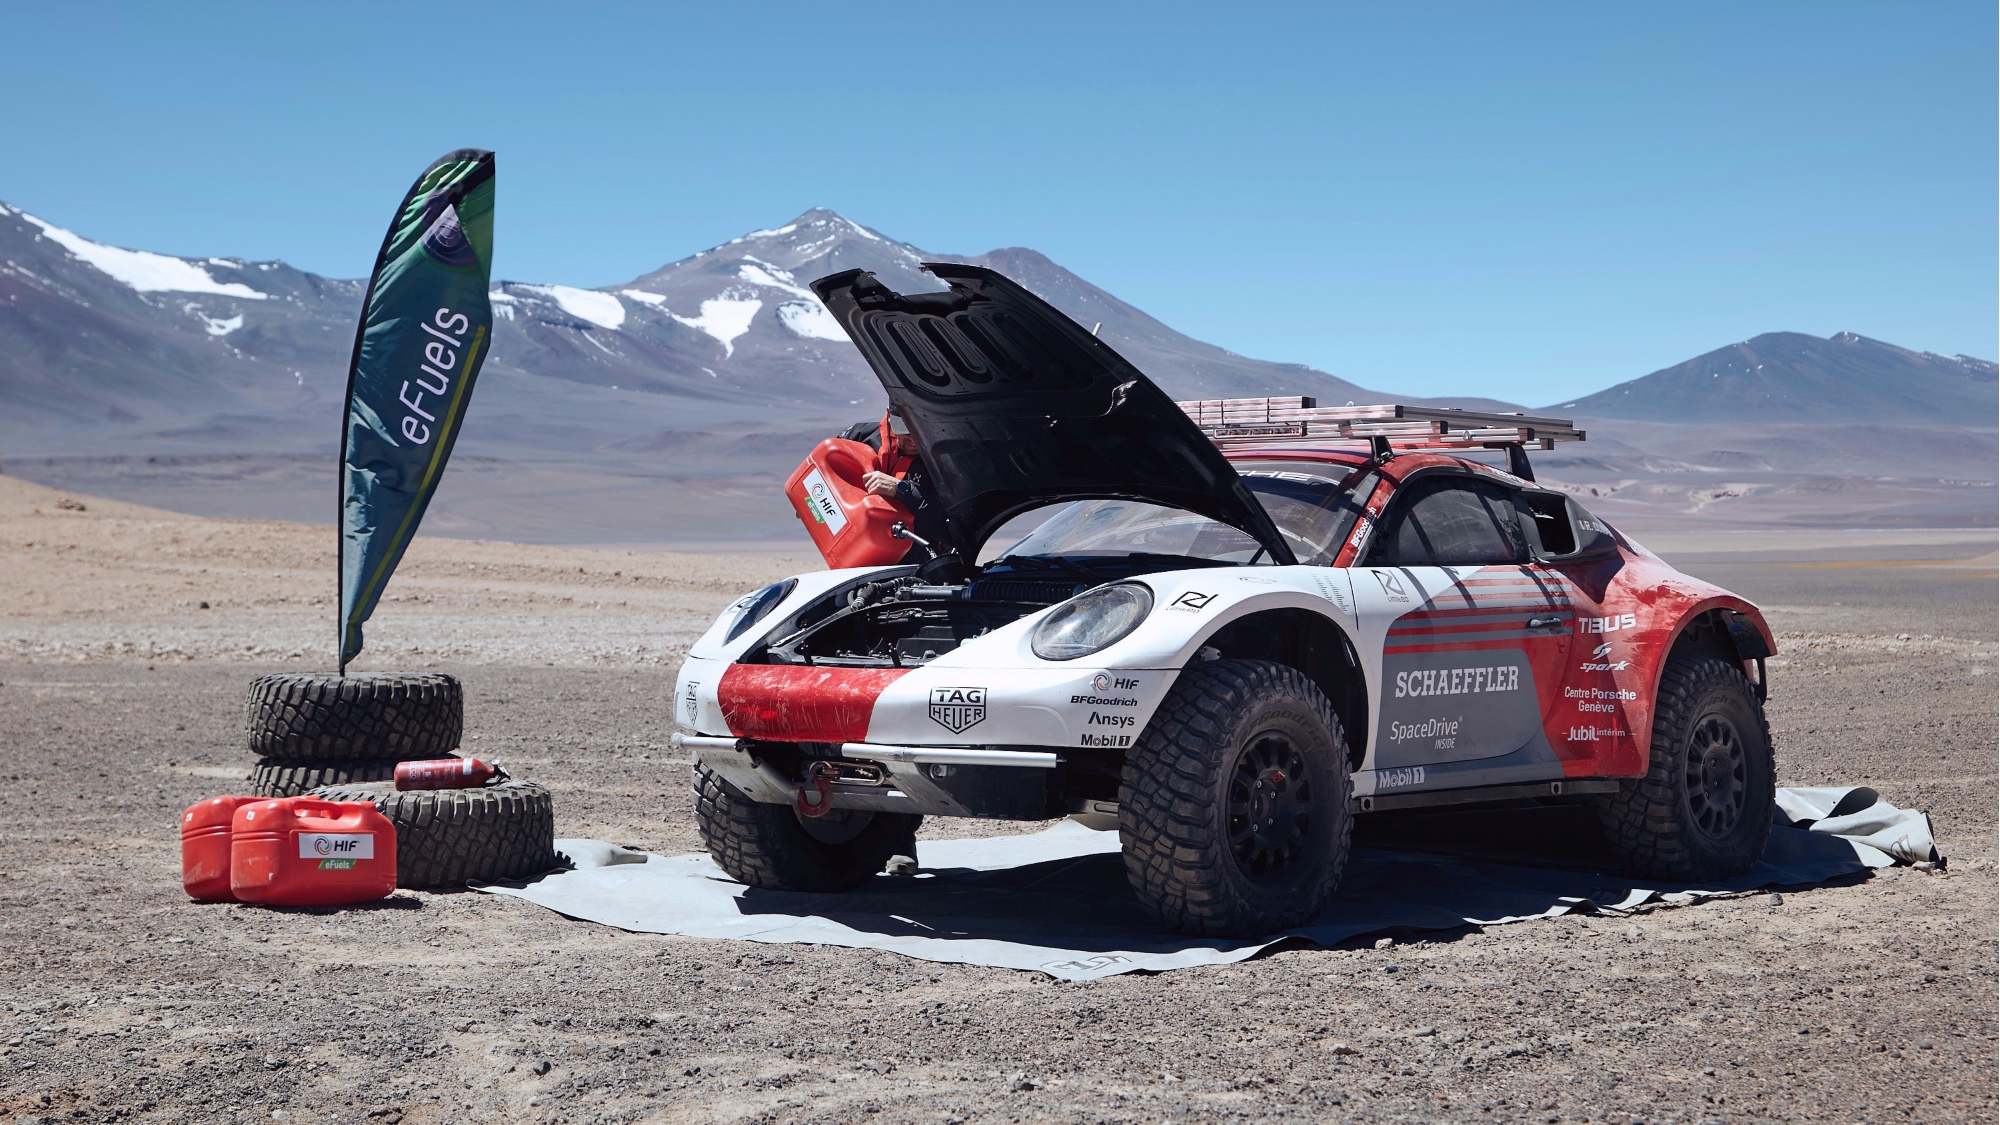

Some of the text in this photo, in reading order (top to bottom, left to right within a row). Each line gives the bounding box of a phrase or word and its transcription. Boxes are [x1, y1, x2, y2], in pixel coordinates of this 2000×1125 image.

[400, 307, 469, 445] eFuels
[819, 497, 836, 517] HIF
[1350, 506, 1377, 548] BFGoodrich
[1578, 614, 1636, 634] TIBUS
[1580, 660, 1630, 672] spark
[1114, 678, 1139, 690] HIF
[1395, 665, 1519, 697] SCHAEFFLER
[936, 690, 981, 703] TAG
[1565, 686, 1637, 700] Centre Porsche
[1070, 695, 1138, 707] BFGoodrich
[1578, 700, 1615, 713] Genève
[932, 707, 982, 730] HEUER
[1088, 711, 1135, 729] Ansys
[1080, 733, 1117, 747] Mobil
[1434, 738, 1456, 750] INSIDE
[1378, 770, 1413, 788] Mobil
[334, 840, 358, 852] HIF
[325, 860, 350, 869] eFuels
